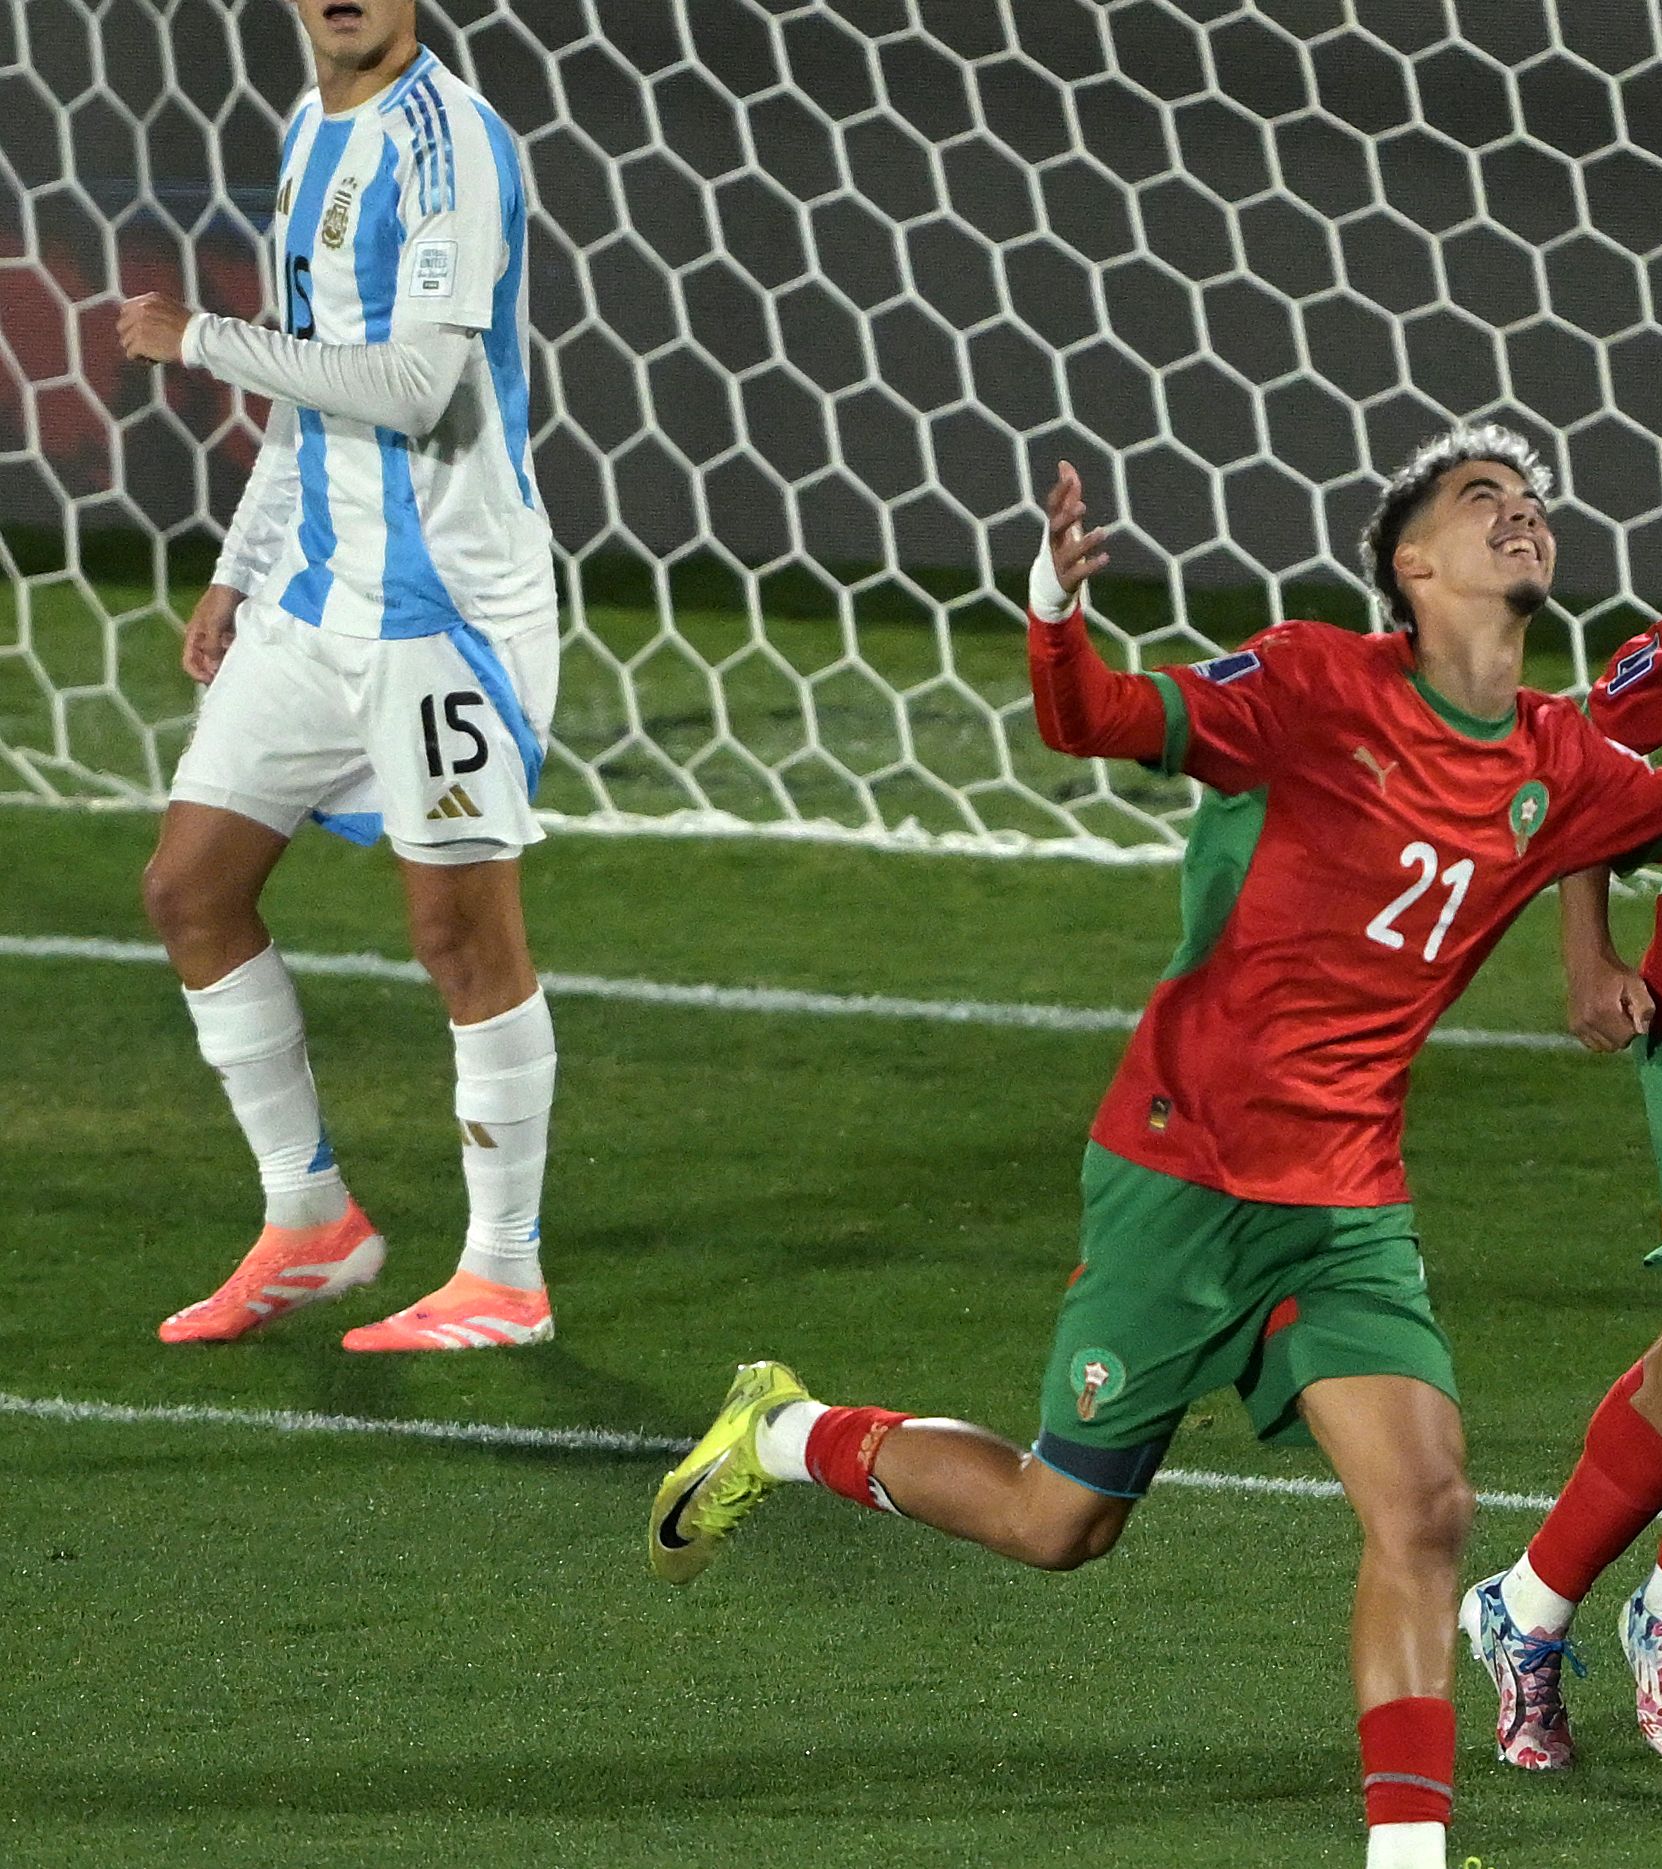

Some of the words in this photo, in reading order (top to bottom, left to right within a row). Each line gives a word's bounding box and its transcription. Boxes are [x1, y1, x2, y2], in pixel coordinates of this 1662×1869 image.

[285, 251, 317, 339] 15
[420, 691, 489, 777] 15
[1366, 841, 1475, 963] 21
